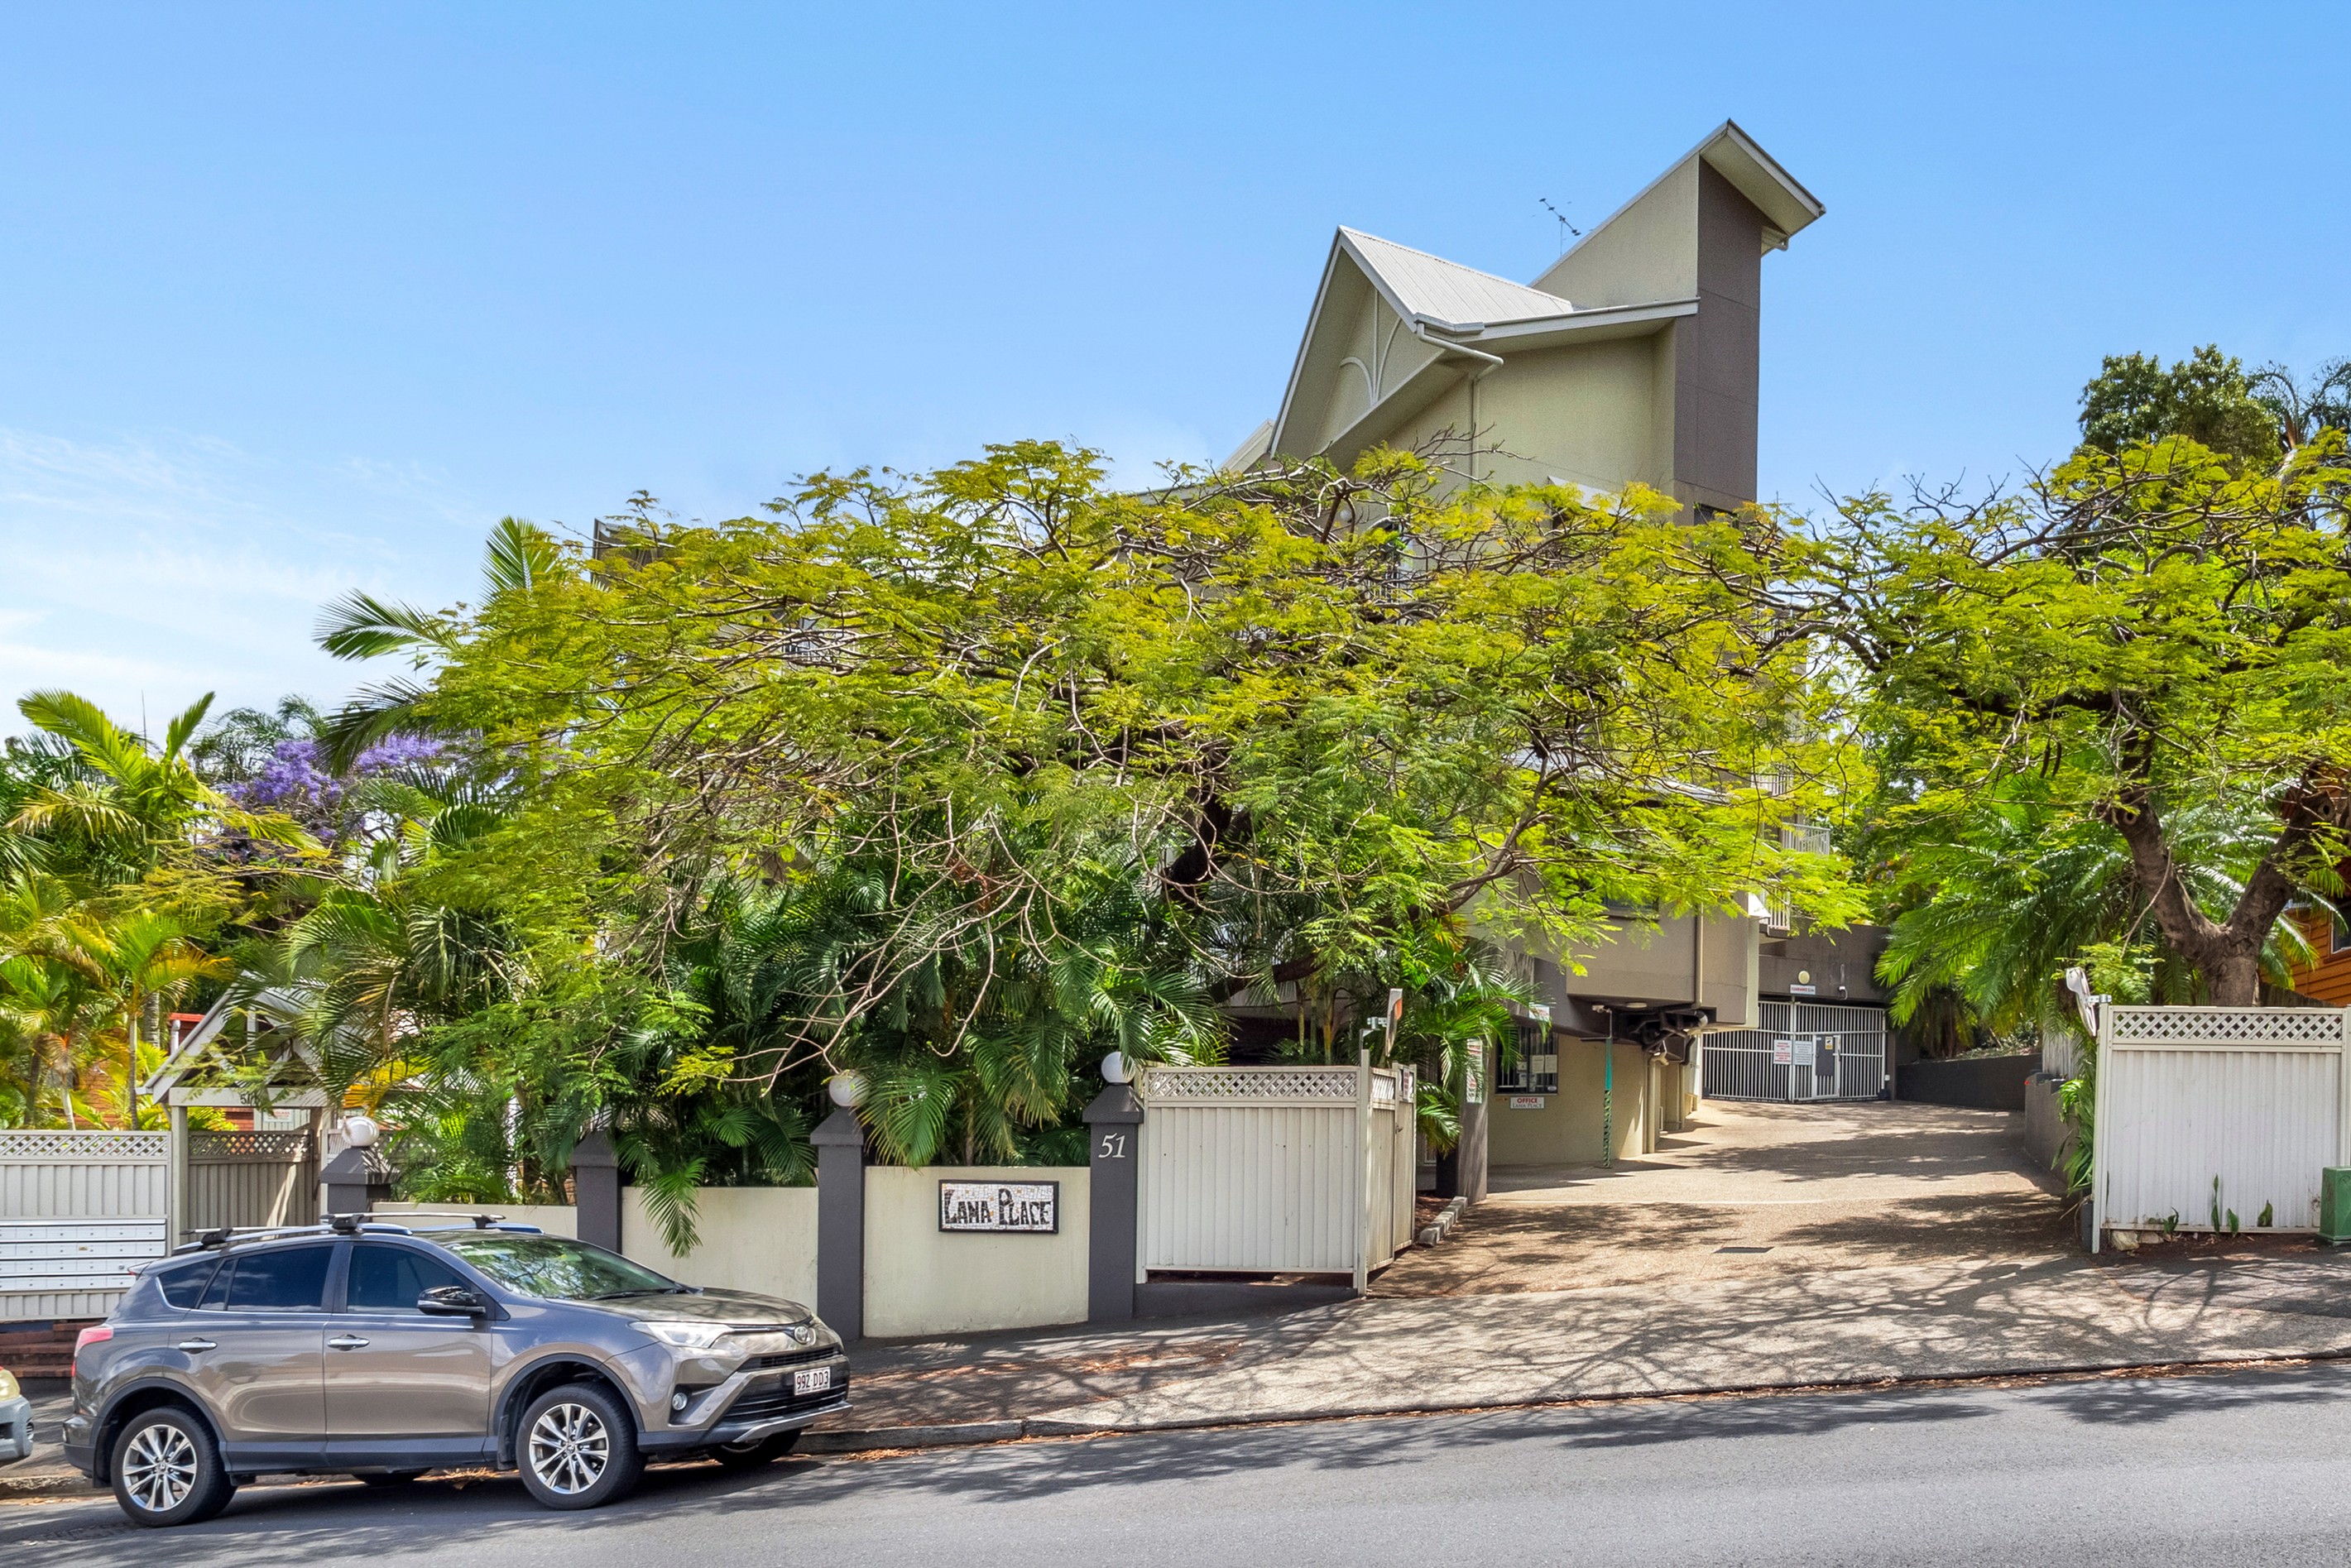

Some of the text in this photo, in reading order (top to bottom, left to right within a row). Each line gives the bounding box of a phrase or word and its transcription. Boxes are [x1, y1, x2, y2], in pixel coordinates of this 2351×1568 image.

[1098, 1133, 1126, 1158] 51
[944, 1187, 1052, 1225] LANA PLACE
[797, 1374, 810, 1389] 992
